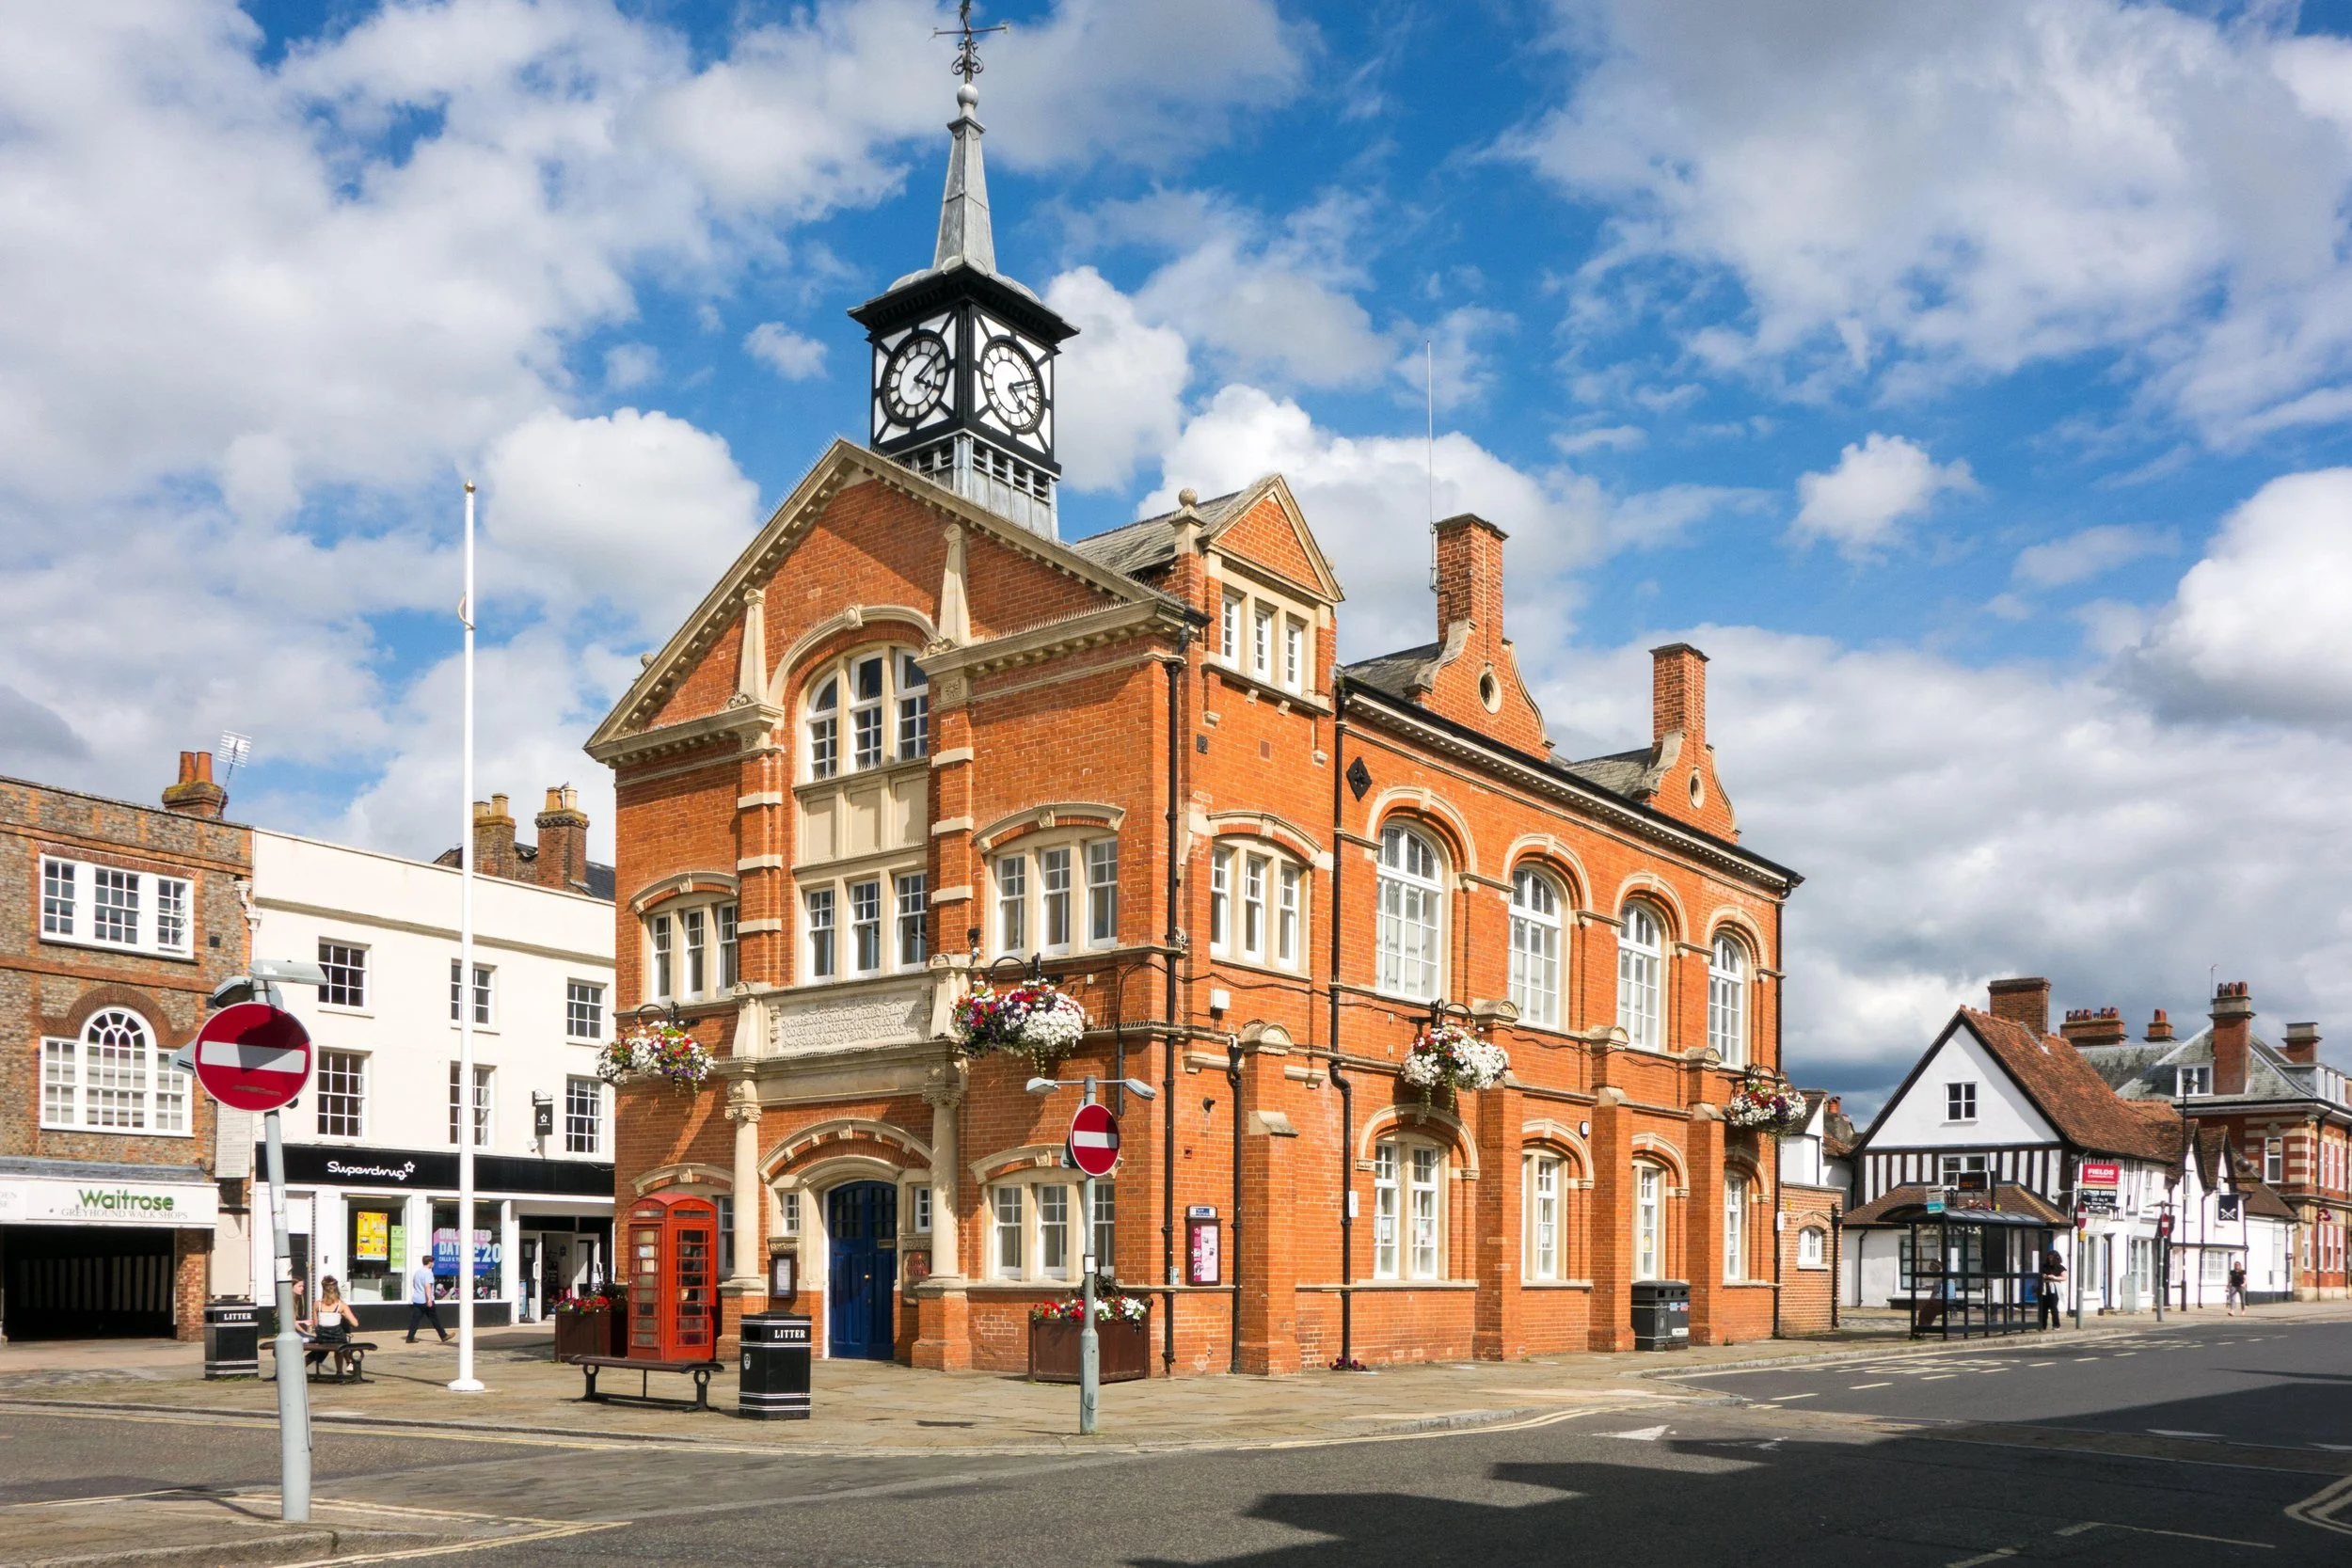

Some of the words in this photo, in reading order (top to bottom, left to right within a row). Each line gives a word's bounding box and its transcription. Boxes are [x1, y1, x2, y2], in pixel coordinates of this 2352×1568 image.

[326, 1161, 407, 1180] Superdrug
[78, 1189, 175, 1211] Waitrose
[61, 1209, 126, 1218] GREYHOUND
[129, 1211, 156, 1219] WALK
[159, 1212, 188, 1220] SHOPS
[439, 1227, 492, 1243] UNLTED
[774, 1329, 805, 1338] LITTER
